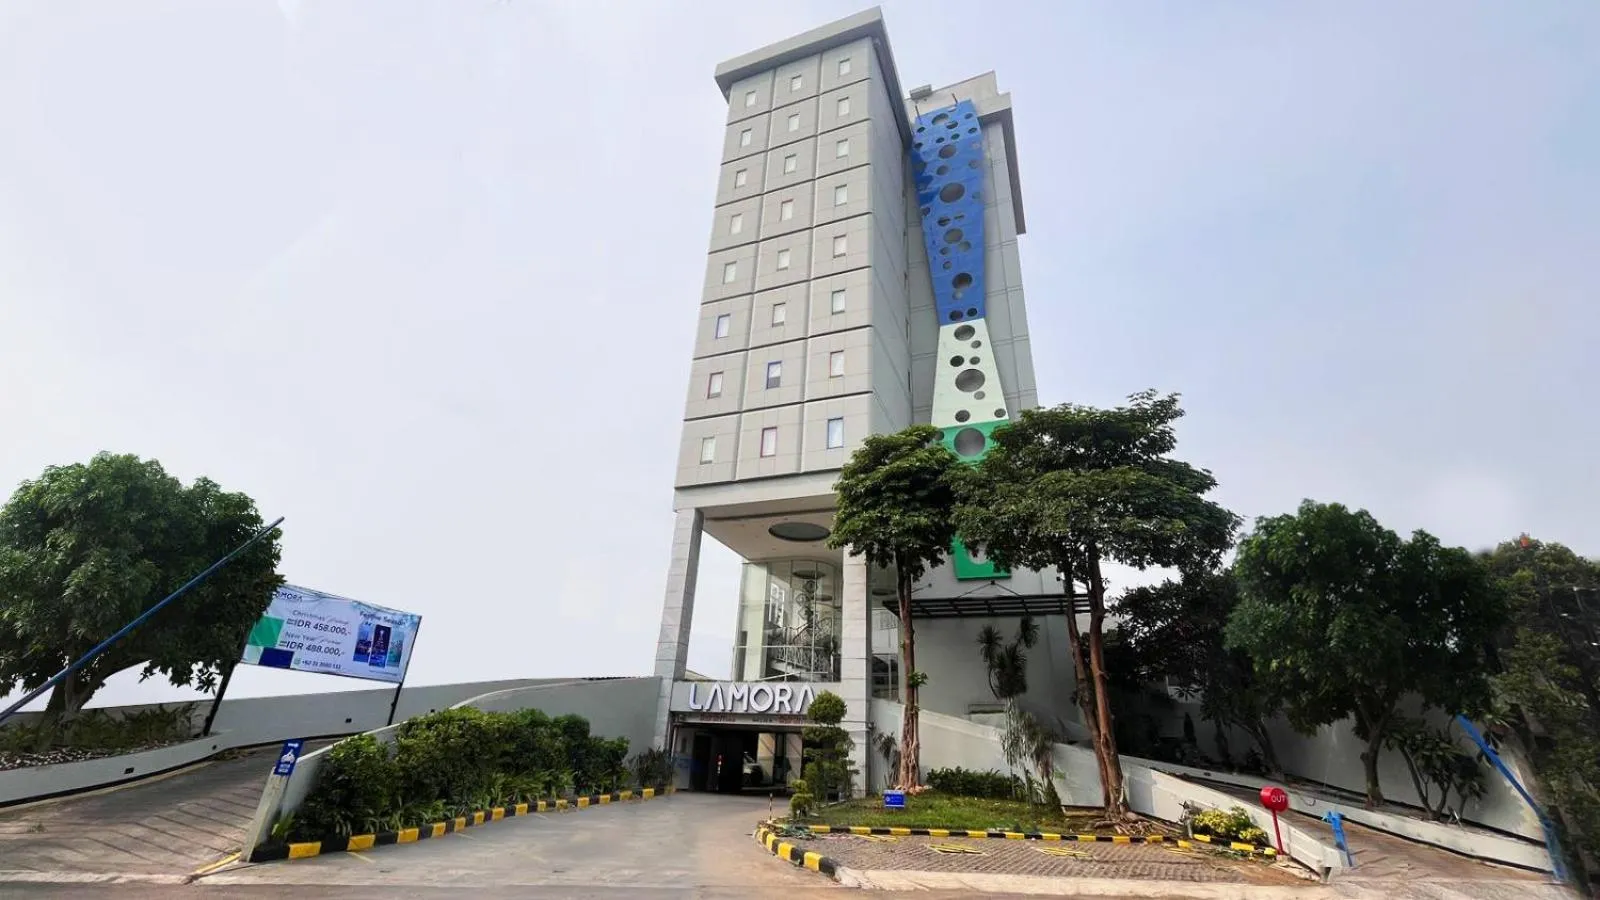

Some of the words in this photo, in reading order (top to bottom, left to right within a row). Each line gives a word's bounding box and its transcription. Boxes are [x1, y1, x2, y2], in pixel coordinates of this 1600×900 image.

[286, 641, 304, 650] IDR
[689, 680, 815, 712] LAMORA
[1271, 795, 1285, 803] OUT
